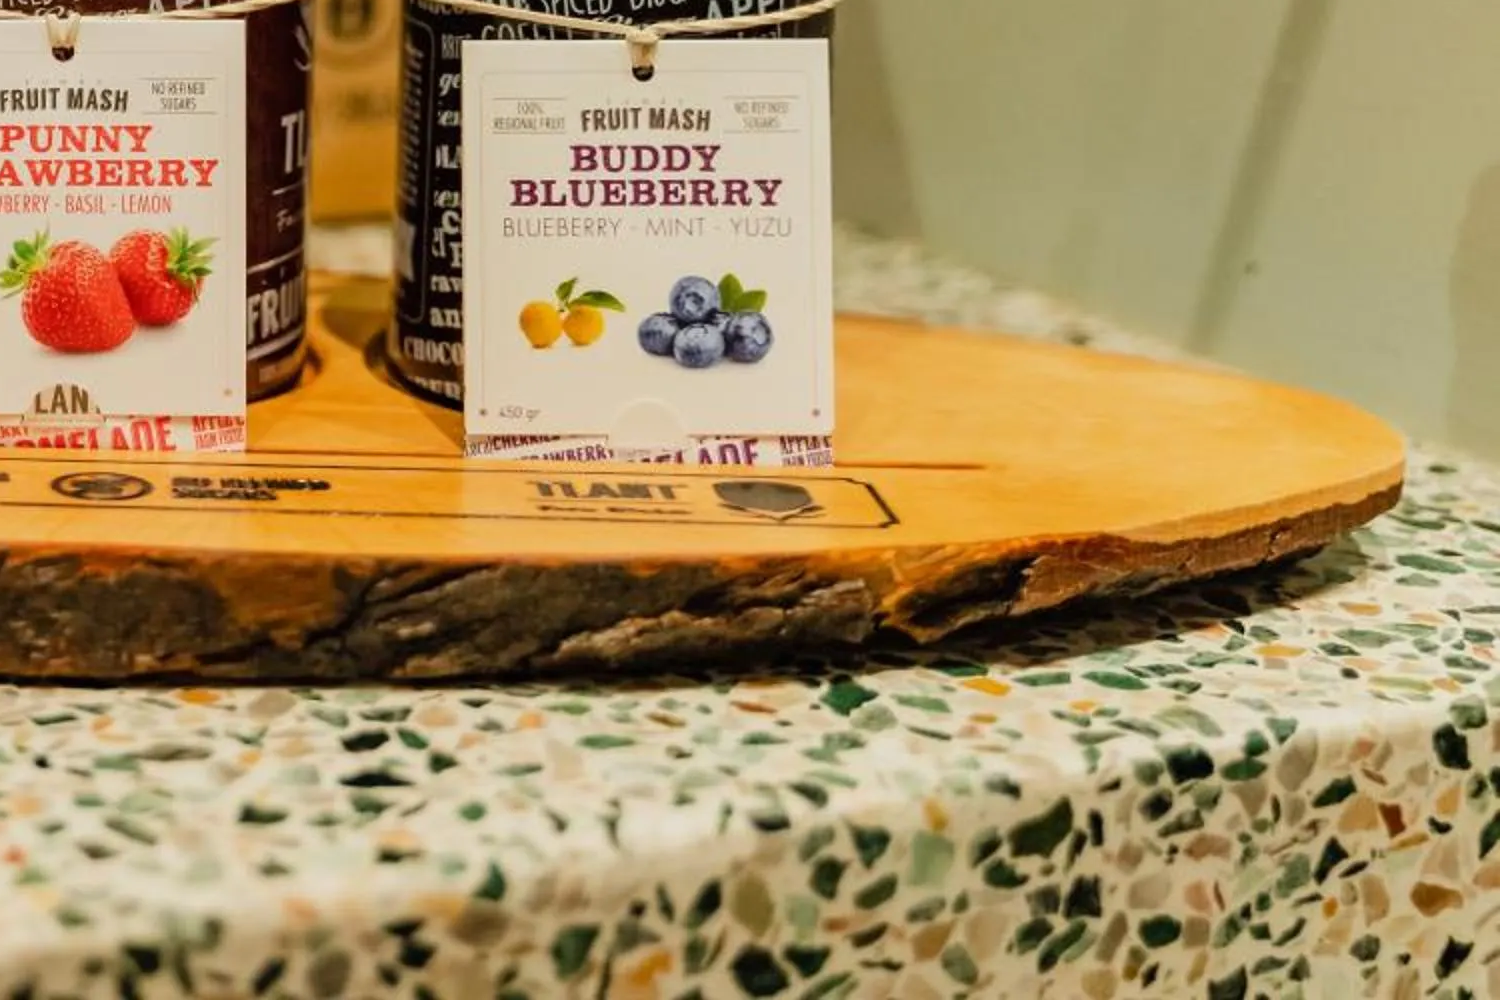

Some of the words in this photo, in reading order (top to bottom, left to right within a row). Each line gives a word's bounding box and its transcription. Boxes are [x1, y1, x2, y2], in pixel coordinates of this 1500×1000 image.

[0, 88, 59, 113] FRUIT
[67, 89, 129, 113] MASH
[581, 108, 640, 133] FRUIT
[648, 108, 711, 132] MASH
[569, 144, 721, 173] BUDDY
[64, 193, 107, 215] BASIL
[121, 193, 173, 215] LEMON
[510, 179, 783, 207] BLUEBERRY
[502, 217, 622, 238] BLUEBERRY
[645, 217, 706, 237] MINT
[731, 217, 792, 238] YUZU
[34, 383, 101, 416] LAN
